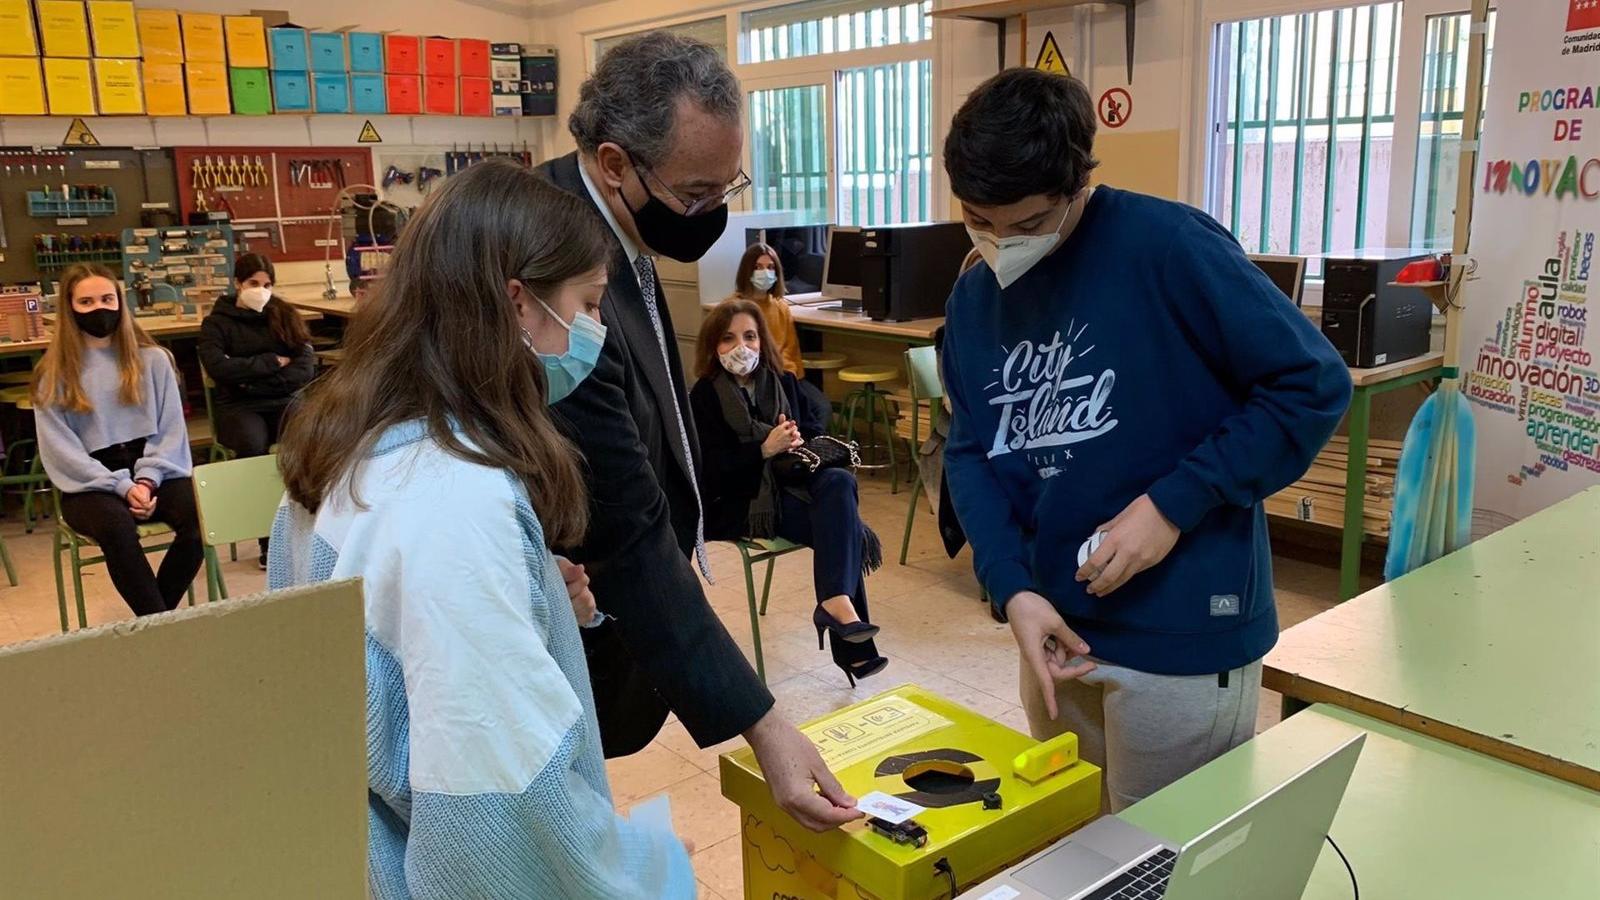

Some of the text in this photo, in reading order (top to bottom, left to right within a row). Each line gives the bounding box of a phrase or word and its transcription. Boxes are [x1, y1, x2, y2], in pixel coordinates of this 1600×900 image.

[1561, 41, 1600, 56] de Madrid
[1518, 86, 1600, 112] PROGRA
[1554, 119, 1583, 142] DE
[1483, 155, 1600, 200] INNOVAC
[1577, 232, 1595, 281] becas
[1538, 258, 1562, 319] aula
[1516, 286, 1540, 361] alumno
[1558, 304, 1588, 321] robot
[1536, 321, 1580, 346] digital
[1002, 331, 1075, 399] City
[1534, 341, 1592, 366] proyecto
[1477, 347, 1583, 396] innovación
[1584, 376, 1600, 393] 3D
[1471, 385, 1516, 405] educación
[987, 368, 1119, 459] Island
[1526, 418, 1599, 455] aprender
